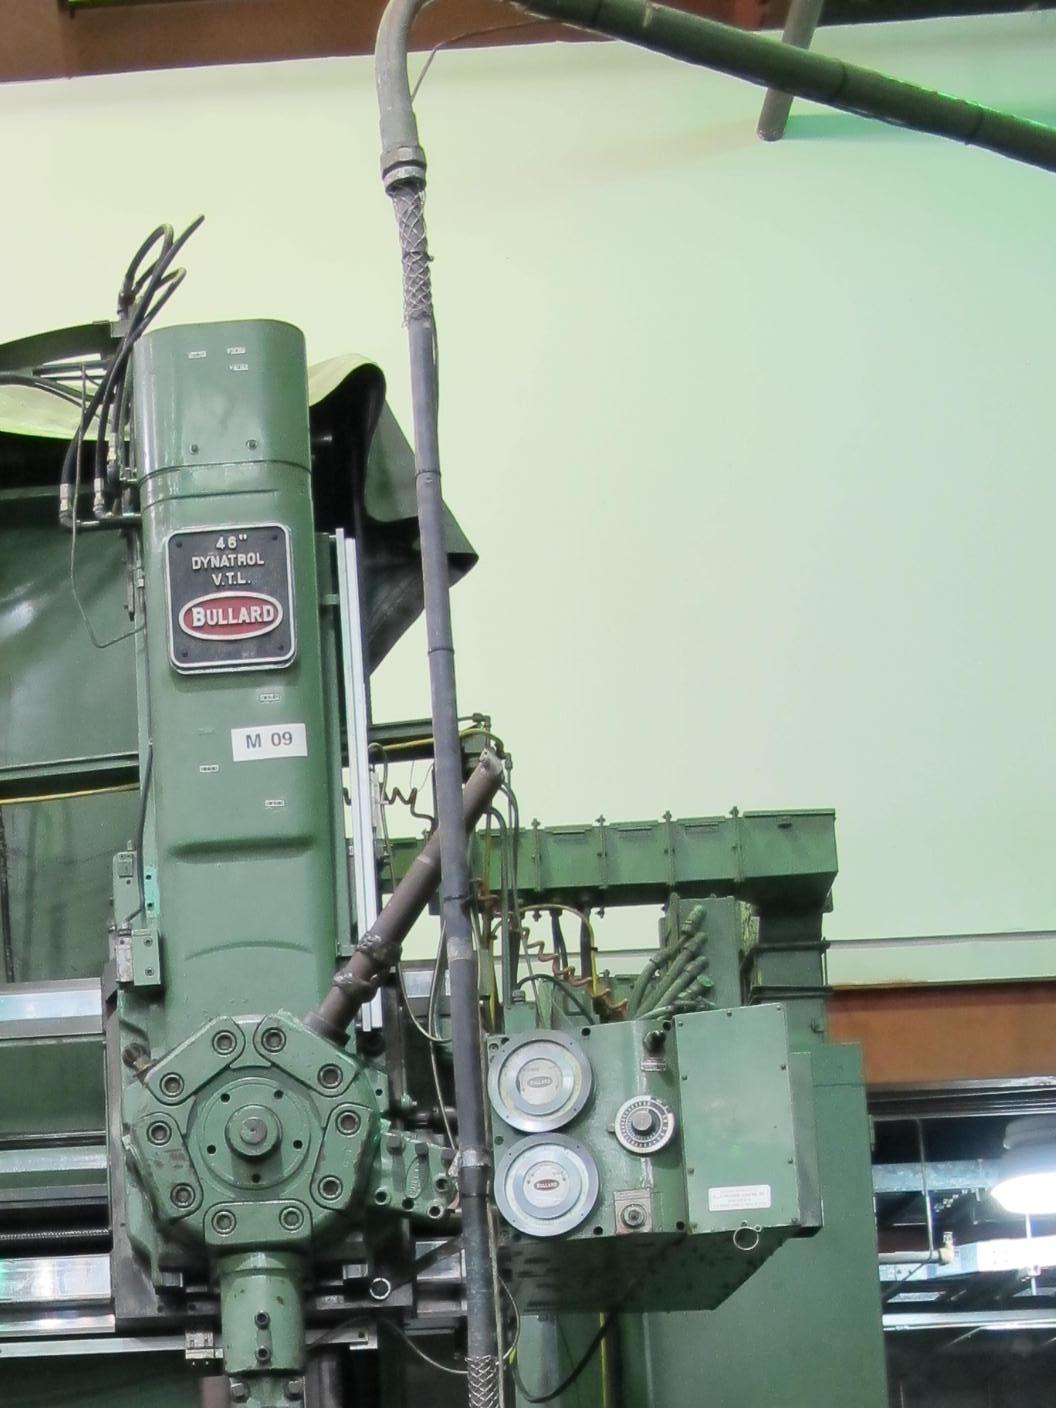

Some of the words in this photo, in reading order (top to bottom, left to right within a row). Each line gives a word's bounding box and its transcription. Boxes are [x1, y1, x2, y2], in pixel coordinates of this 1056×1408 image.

[215, 534, 247, 550] 46"
[191, 552, 265, 570] DYNATROL
[211, 571, 252, 587] V.T.L.
[191, 604, 275, 628] BULLARD
[245, 733, 262, 749] M
[270, 731, 294, 747] 09
